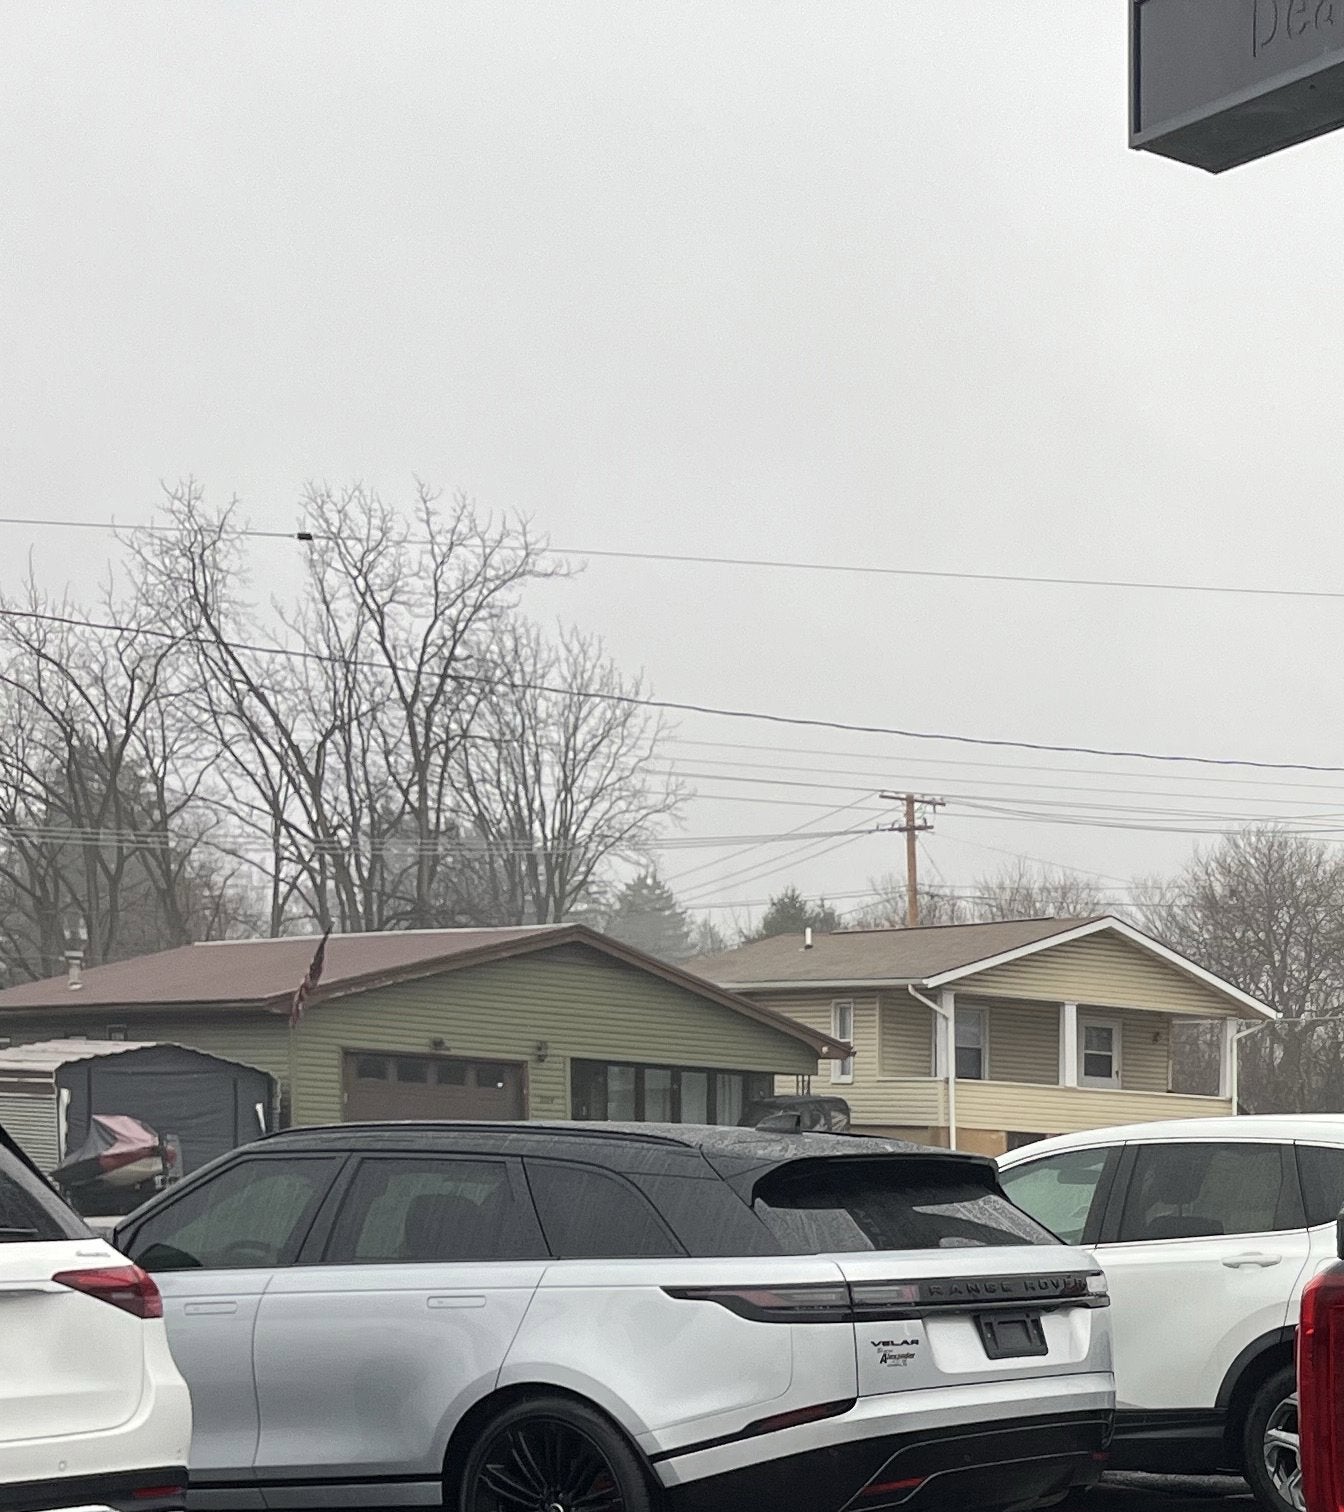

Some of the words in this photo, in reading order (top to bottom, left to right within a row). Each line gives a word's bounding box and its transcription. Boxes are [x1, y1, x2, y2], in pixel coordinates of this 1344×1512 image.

[927, 1281, 1014, 1298] RANGE
[1023, 1277, 1088, 1292] ROVER
[870, 1339, 919, 1347] VELAR
